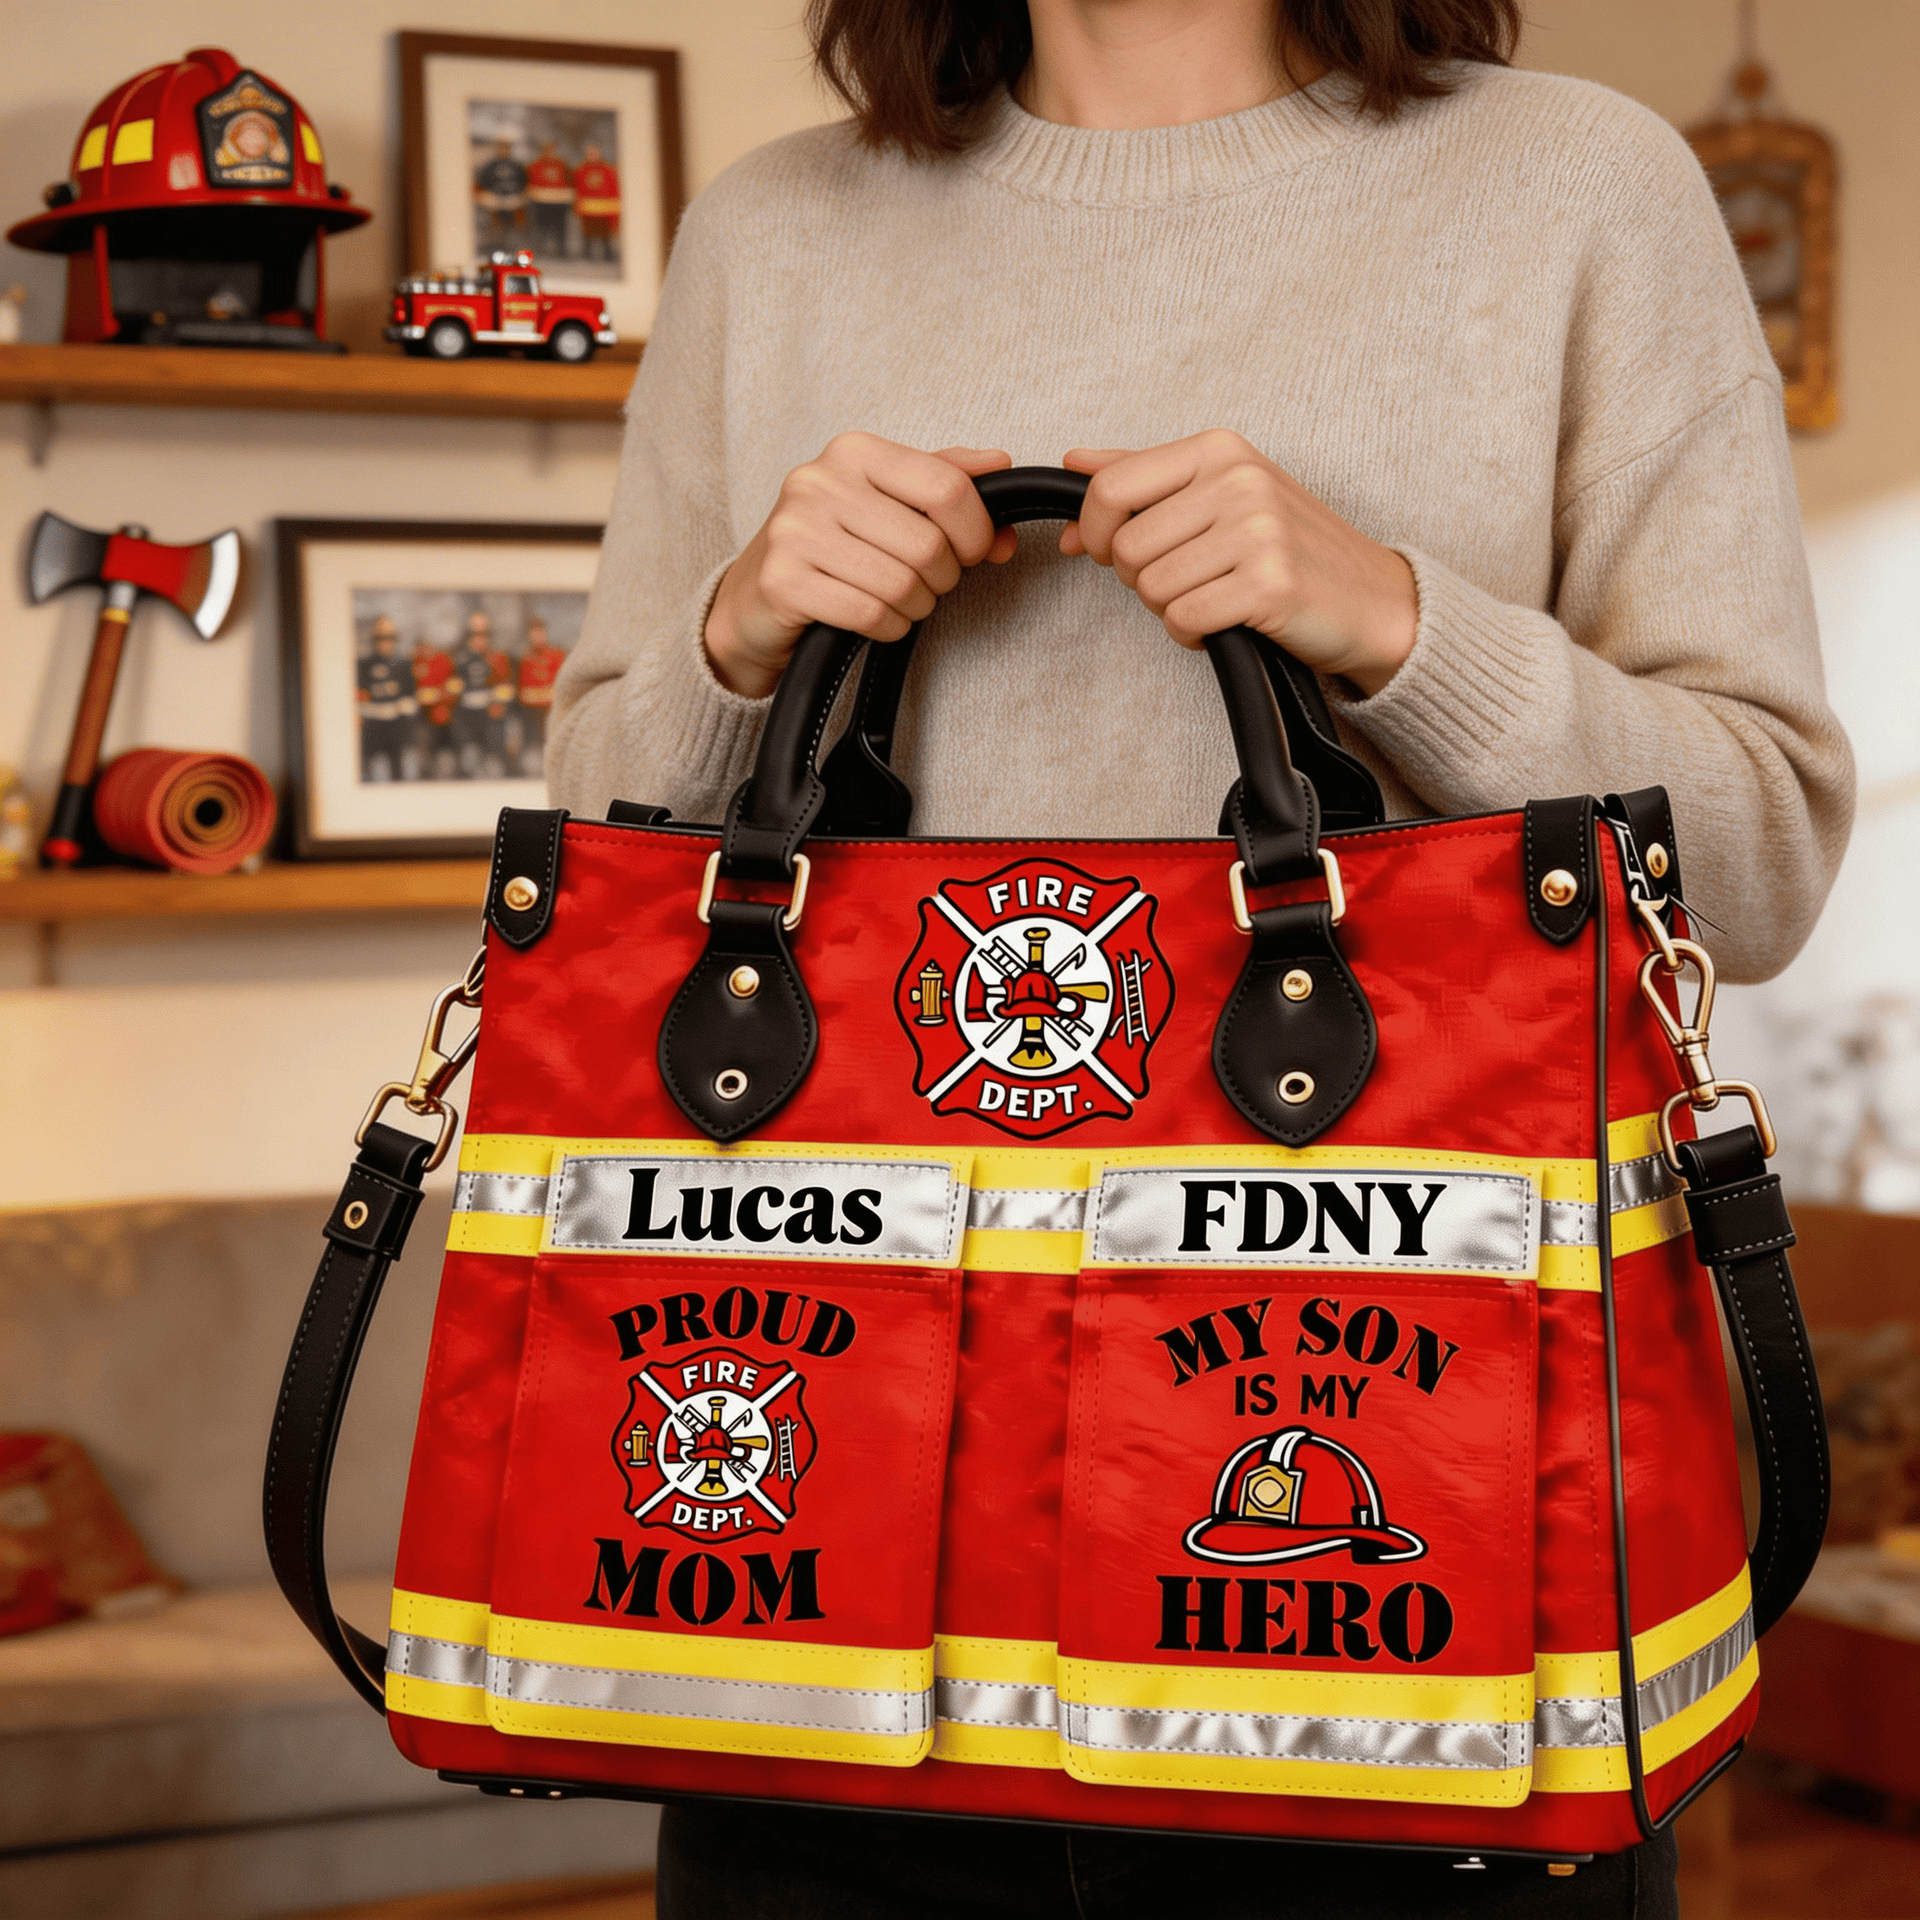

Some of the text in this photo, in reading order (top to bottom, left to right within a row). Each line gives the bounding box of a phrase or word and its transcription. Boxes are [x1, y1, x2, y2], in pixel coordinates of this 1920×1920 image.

[988, 876, 1097, 916] FIRE
[978, 1079, 1094, 1119] DEPT.
[621, 1167, 883, 1246] Lucas
[1177, 1180, 1448, 1257] FDNY
[608, 1286, 857, 1362] PROUD
[1153, 1297, 1461, 1396] MY SON
[682, 1360, 759, 1390] FIRE
[1234, 1373, 1371, 1420] IS MY
[672, 1502, 754, 1532] DEPT.
[582, 1537, 827, 1627] MOM
[1154, 1575, 1456, 1664] HERO
